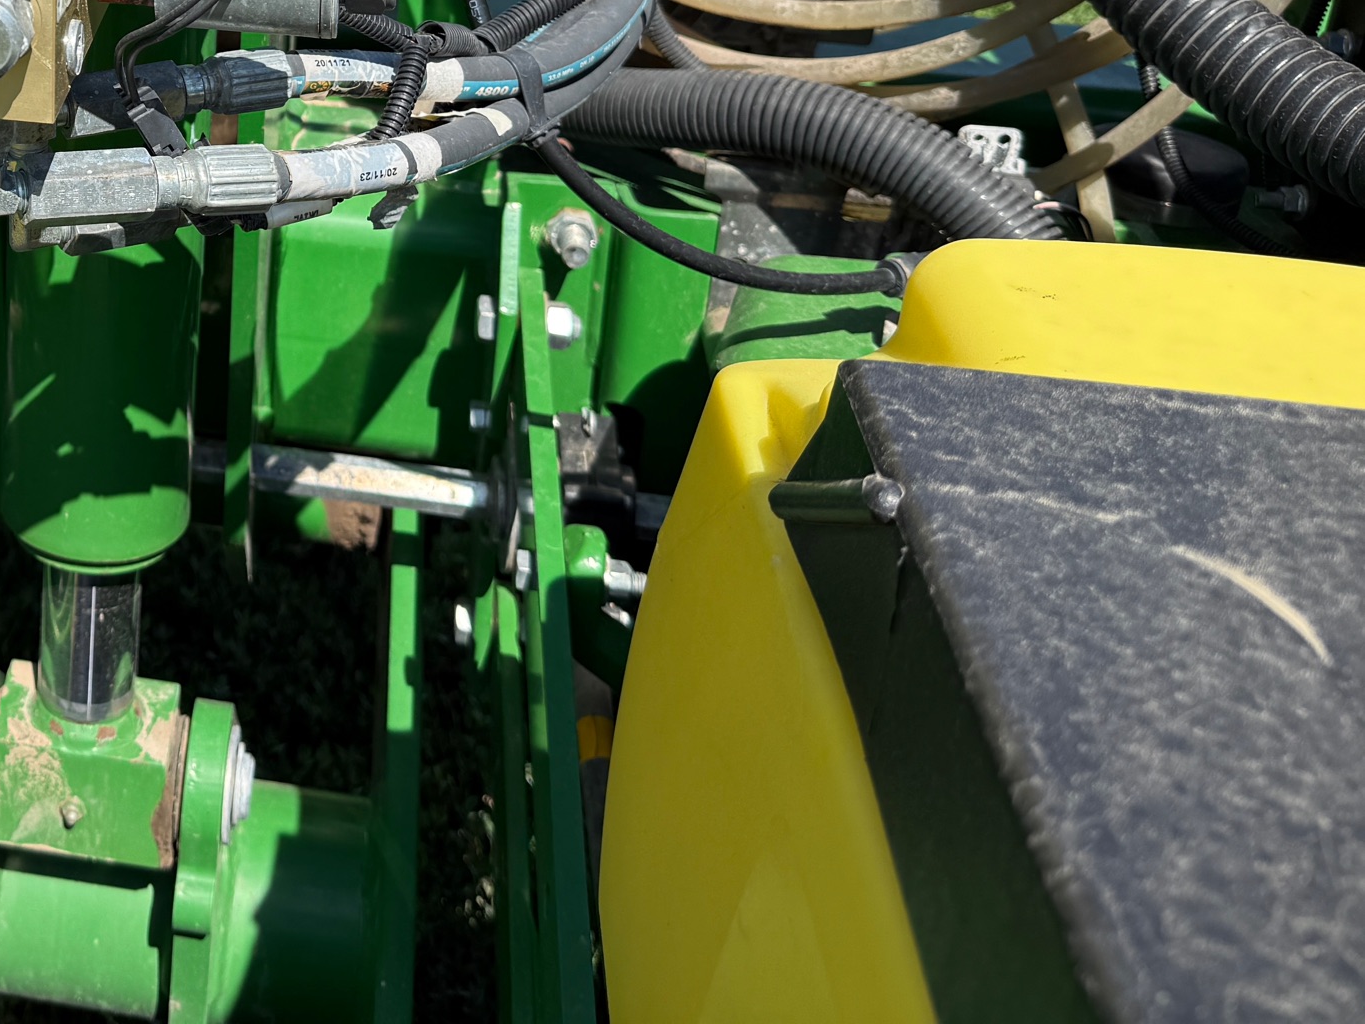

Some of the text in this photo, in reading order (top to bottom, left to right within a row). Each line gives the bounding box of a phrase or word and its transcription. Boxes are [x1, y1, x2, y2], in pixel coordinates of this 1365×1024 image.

[314, 59, 352, 67] 20/11/21
[474, 85, 509, 97] 4800
[359, 166, 398, 182] 20/11/23
